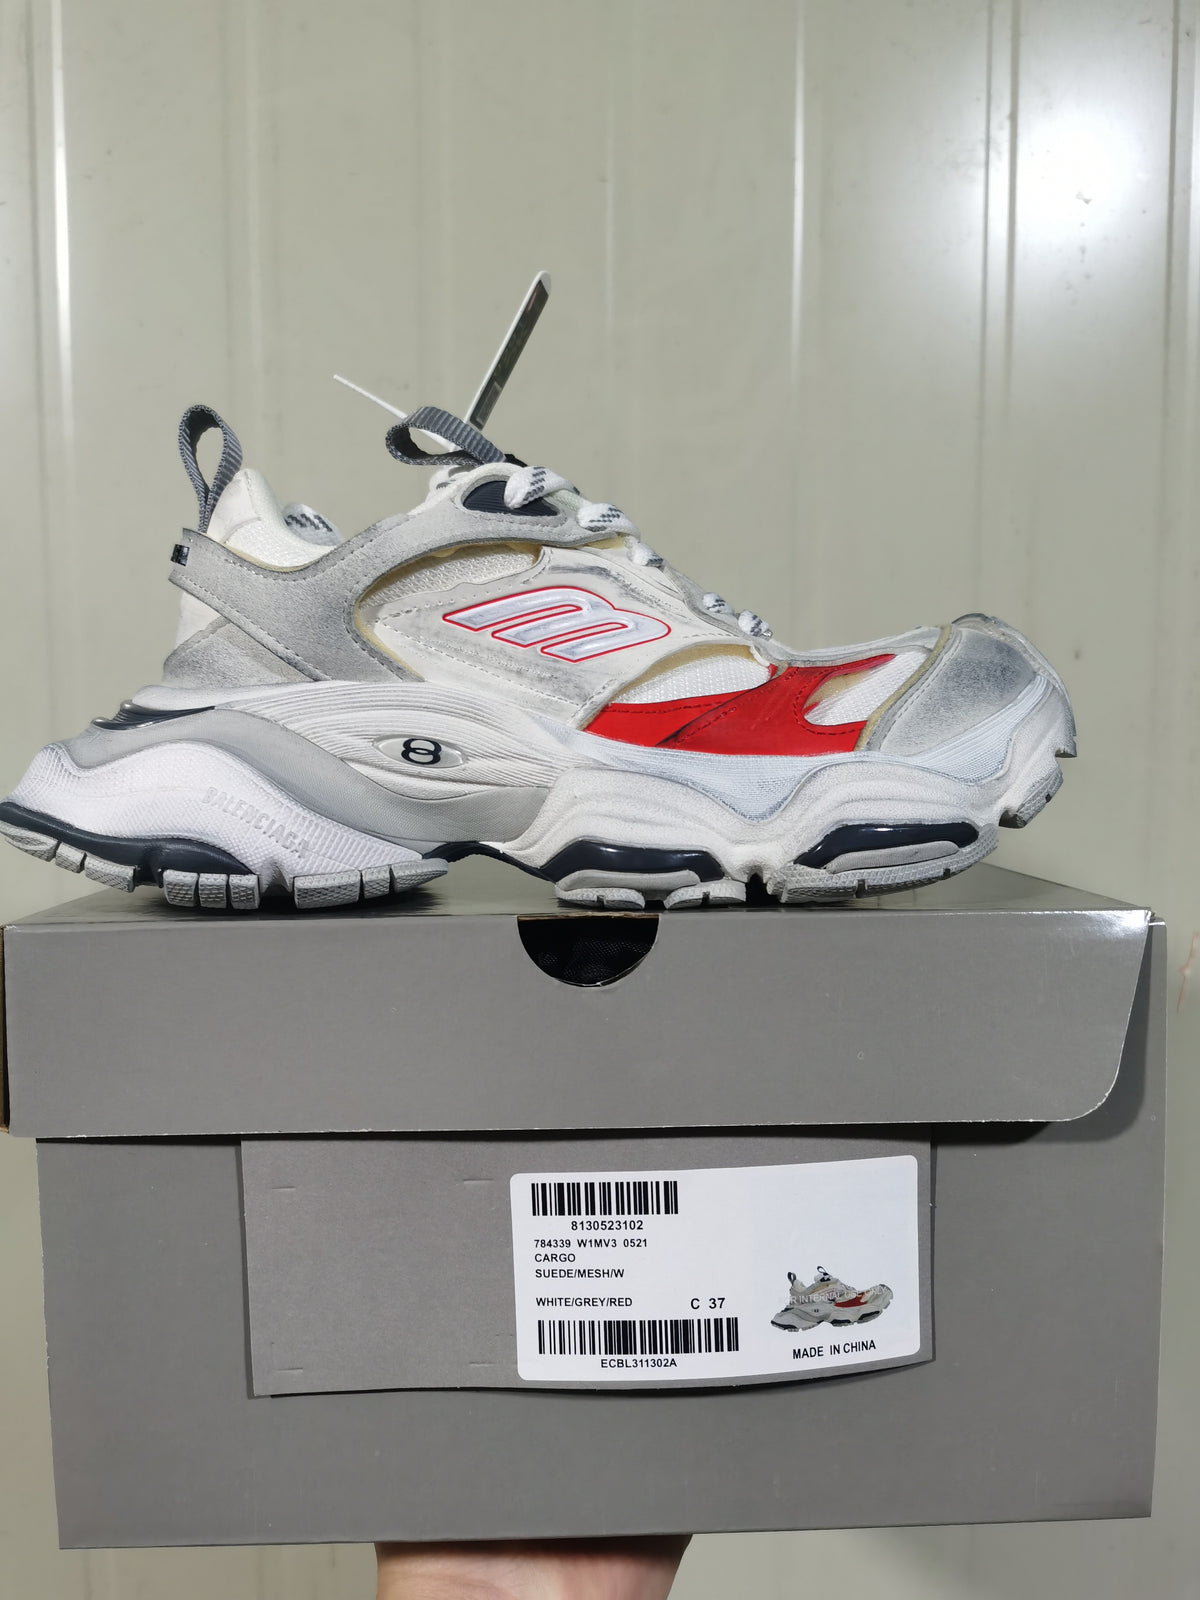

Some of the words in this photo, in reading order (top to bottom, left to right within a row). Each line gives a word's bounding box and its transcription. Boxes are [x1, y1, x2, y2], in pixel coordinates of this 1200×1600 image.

[201, 786, 309, 859] BALENCIAGA
[570, 1219, 644, 1231] 8130523102
[533, 1238, 572, 1249] 784339
[576, 1238, 617, 1248] W1MV3
[622, 1238, 648, 1248] 0521
[534, 1253, 576, 1263] CARGO
[535, 1268, 625, 1279] SUEDE/MESH/W
[535, 1297, 633, 1307] WHITE/GREY/RED
[690, 1298, 701, 1310] C
[708, 1297, 726, 1310] 37
[792, 1345, 824, 1360] MADE
[829, 1343, 841, 1356] IN
[843, 1339, 877, 1354] CHINA
[600, 1358, 678, 1369] ECBL311302A
